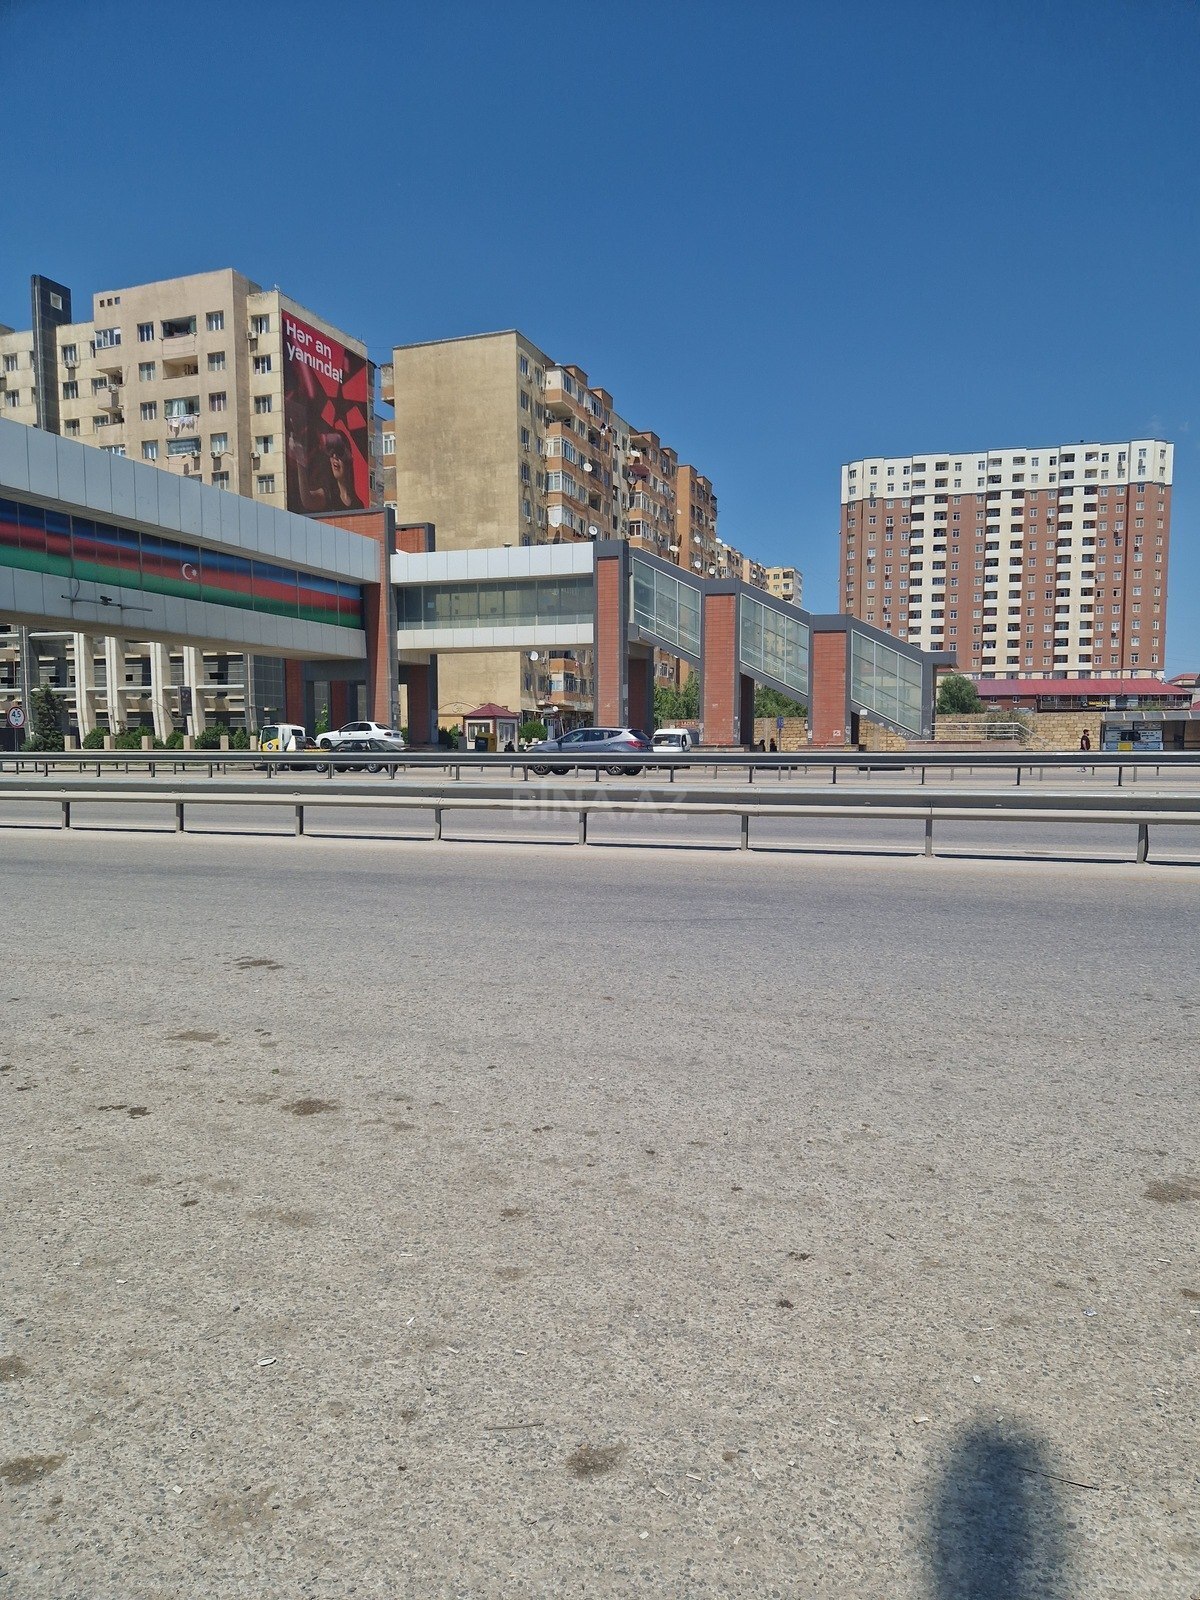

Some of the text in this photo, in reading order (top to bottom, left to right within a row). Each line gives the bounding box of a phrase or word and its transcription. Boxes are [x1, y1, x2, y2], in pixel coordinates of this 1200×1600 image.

[286, 319, 332, 359] Hər an
[286, 341, 343, 384] yanında!
